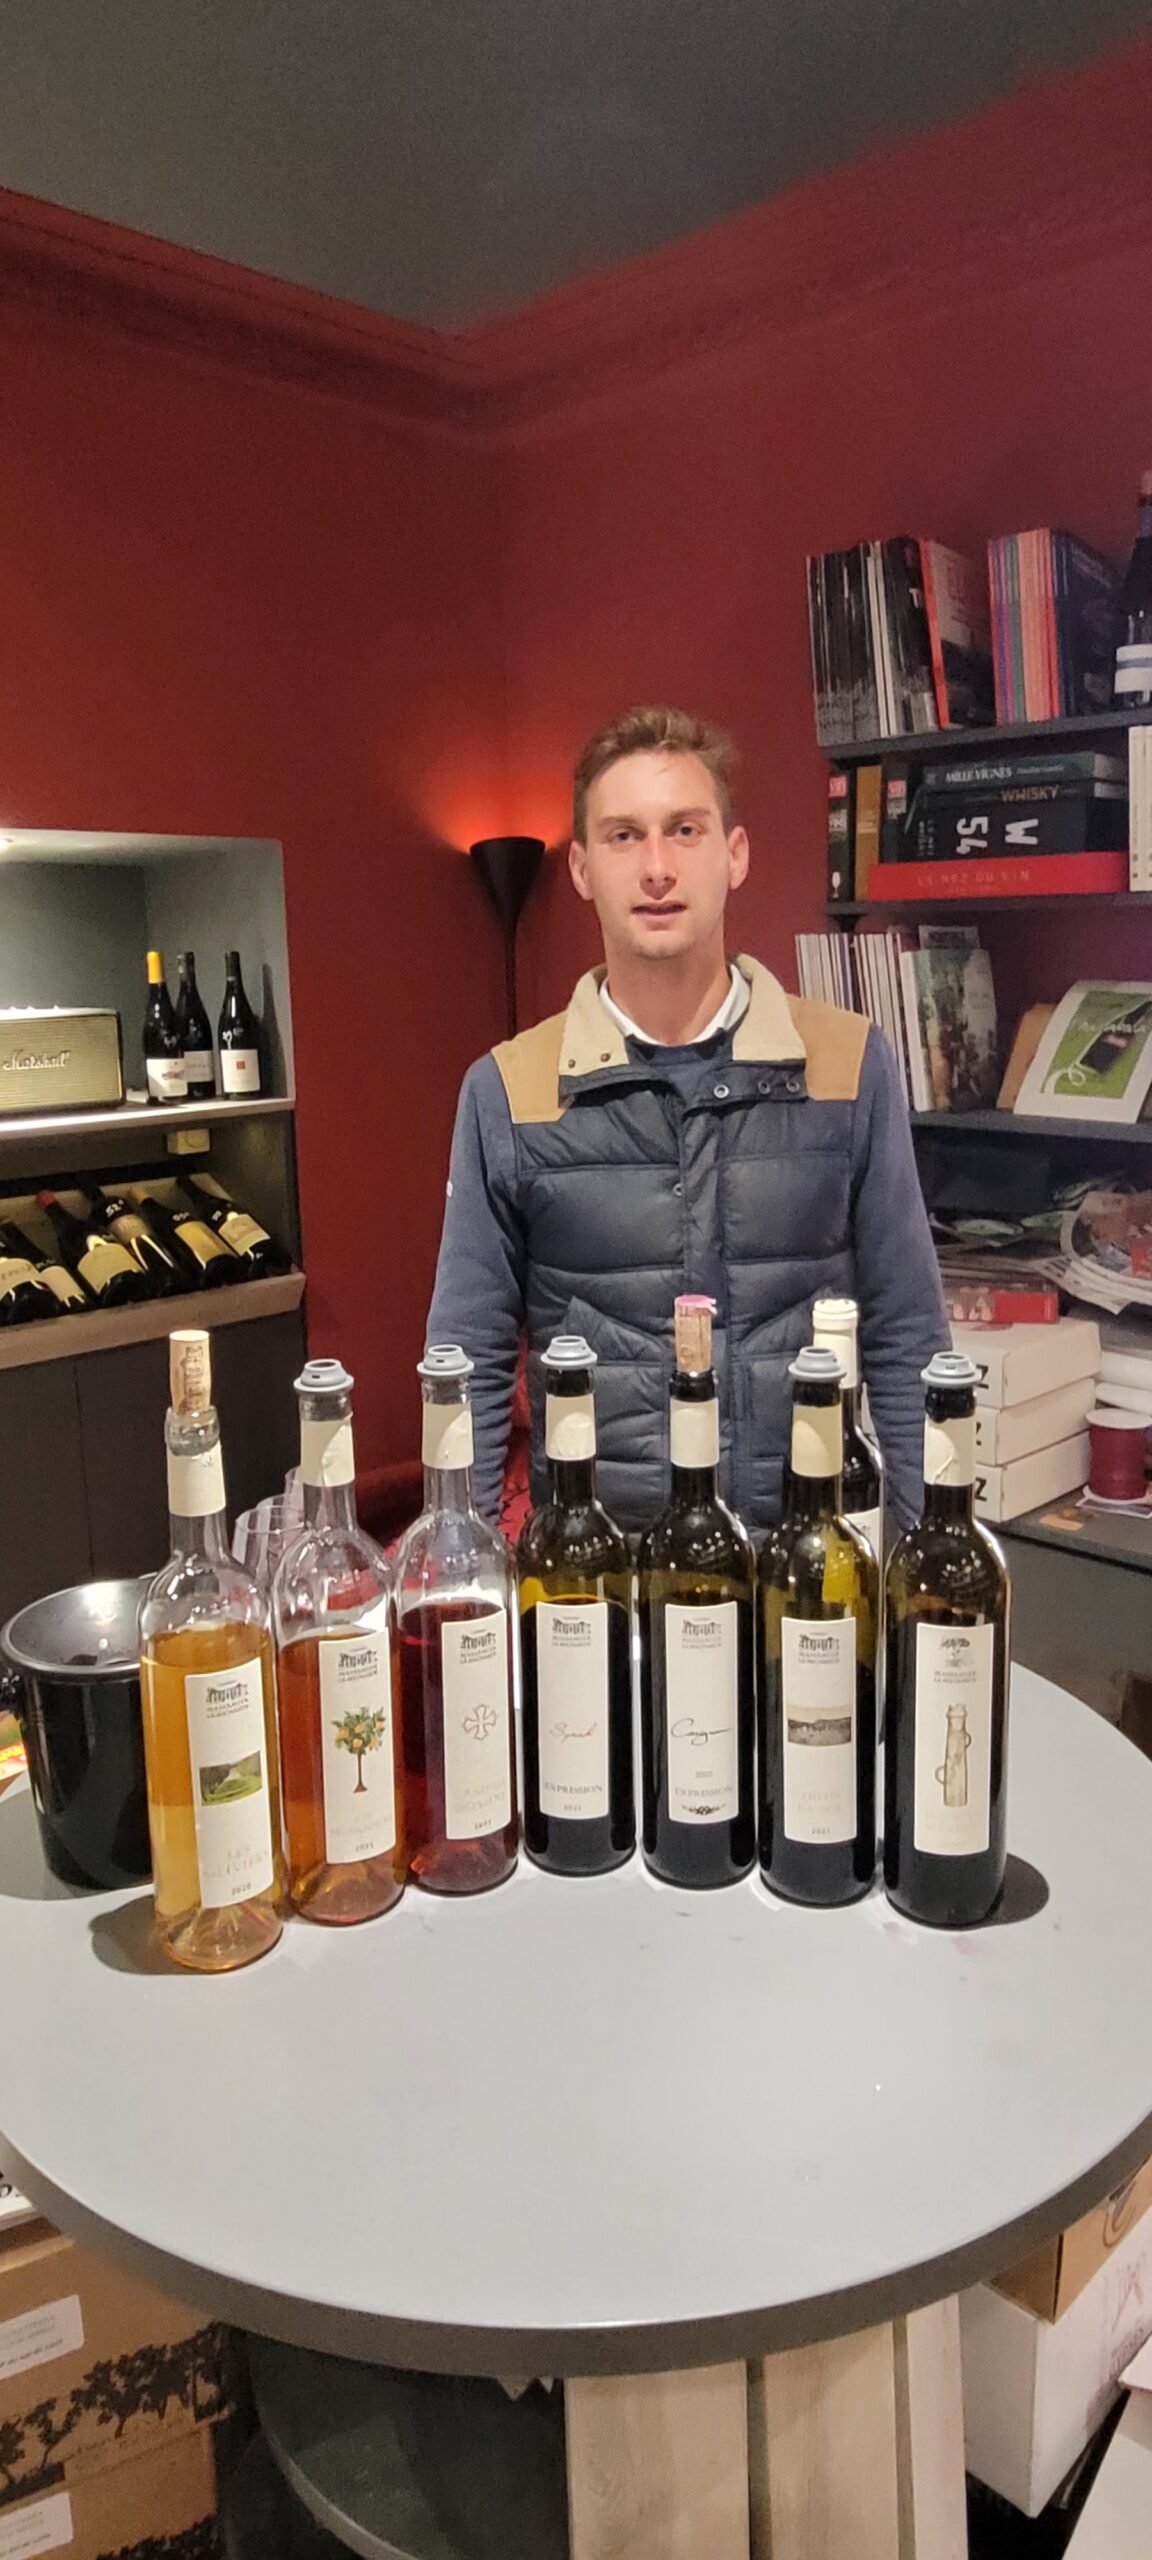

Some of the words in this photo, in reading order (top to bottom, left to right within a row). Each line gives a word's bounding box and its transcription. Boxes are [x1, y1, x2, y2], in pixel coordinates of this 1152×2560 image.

[1000, 784, 1060, 802] WHISKY
[956, 816, 989, 855] 54
[1004, 818, 1039, 845] W
[2, 1050, 70, 1070] Marshall
[544, 1782, 603, 1797] EXPRESSION
[674, 1785, 733, 1798] EXPRESSION
